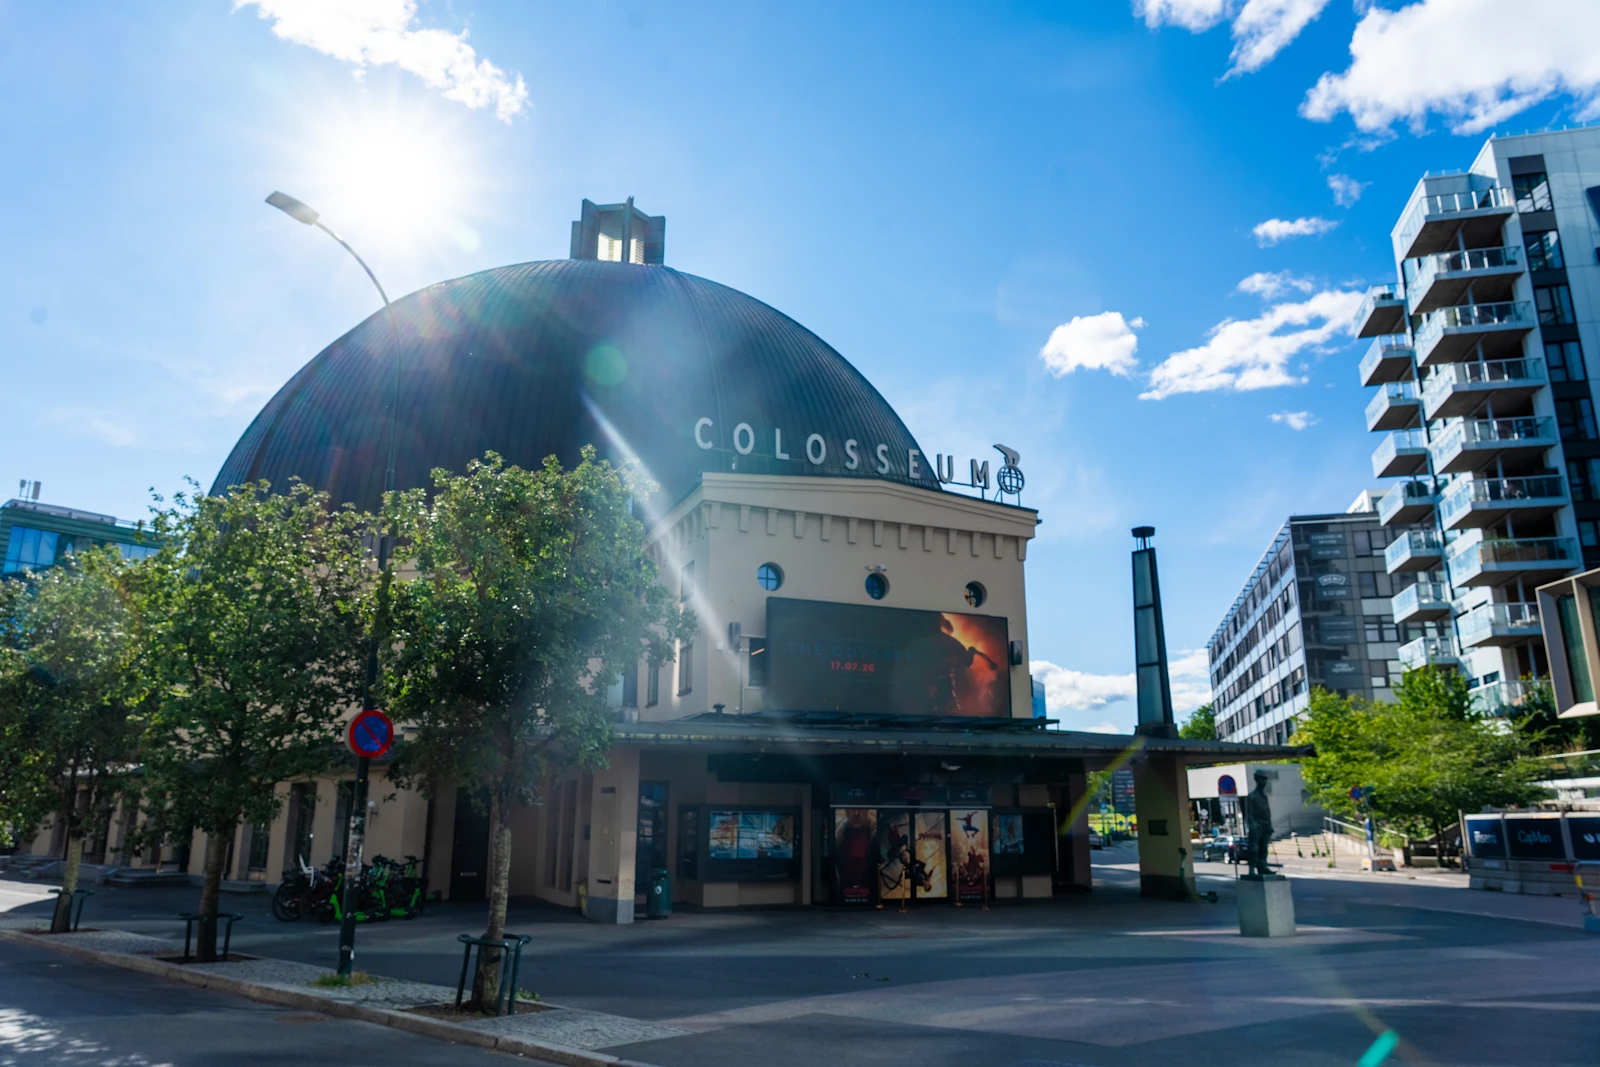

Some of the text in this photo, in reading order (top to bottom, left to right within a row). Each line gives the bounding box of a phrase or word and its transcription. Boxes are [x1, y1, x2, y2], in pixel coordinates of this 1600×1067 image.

[694, 417, 990, 490] COLOSSEUM
[788, 642, 915, 662] THE ODYSSEY
[830, 661, 875, 673] 17.07.26
